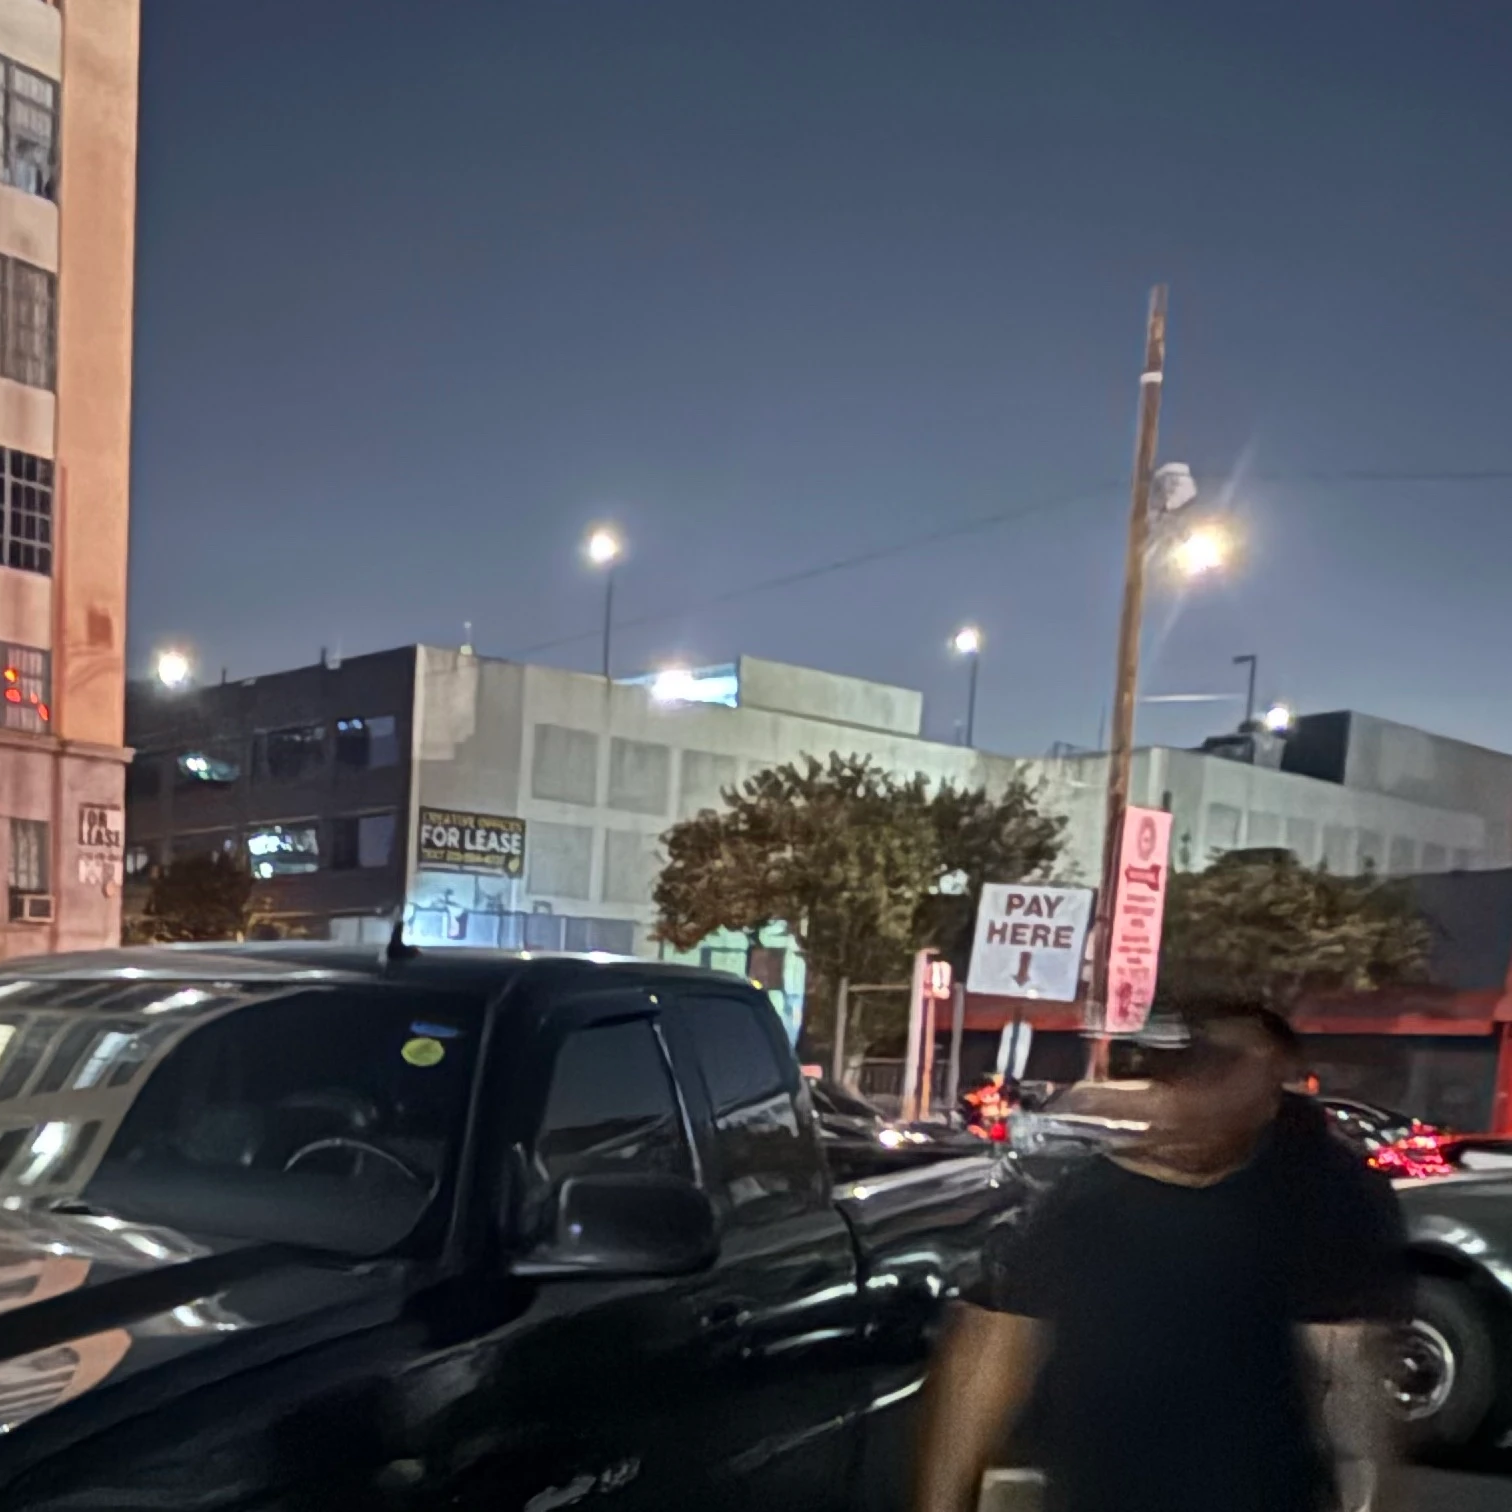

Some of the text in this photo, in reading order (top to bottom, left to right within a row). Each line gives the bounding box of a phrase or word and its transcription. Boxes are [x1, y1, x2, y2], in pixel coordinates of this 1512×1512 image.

[421, 824, 460, 848] FOR
[464, 828, 522, 855] LEASE
[1005, 893, 1065, 918] PAY
[986, 920, 1075, 949] HERE
